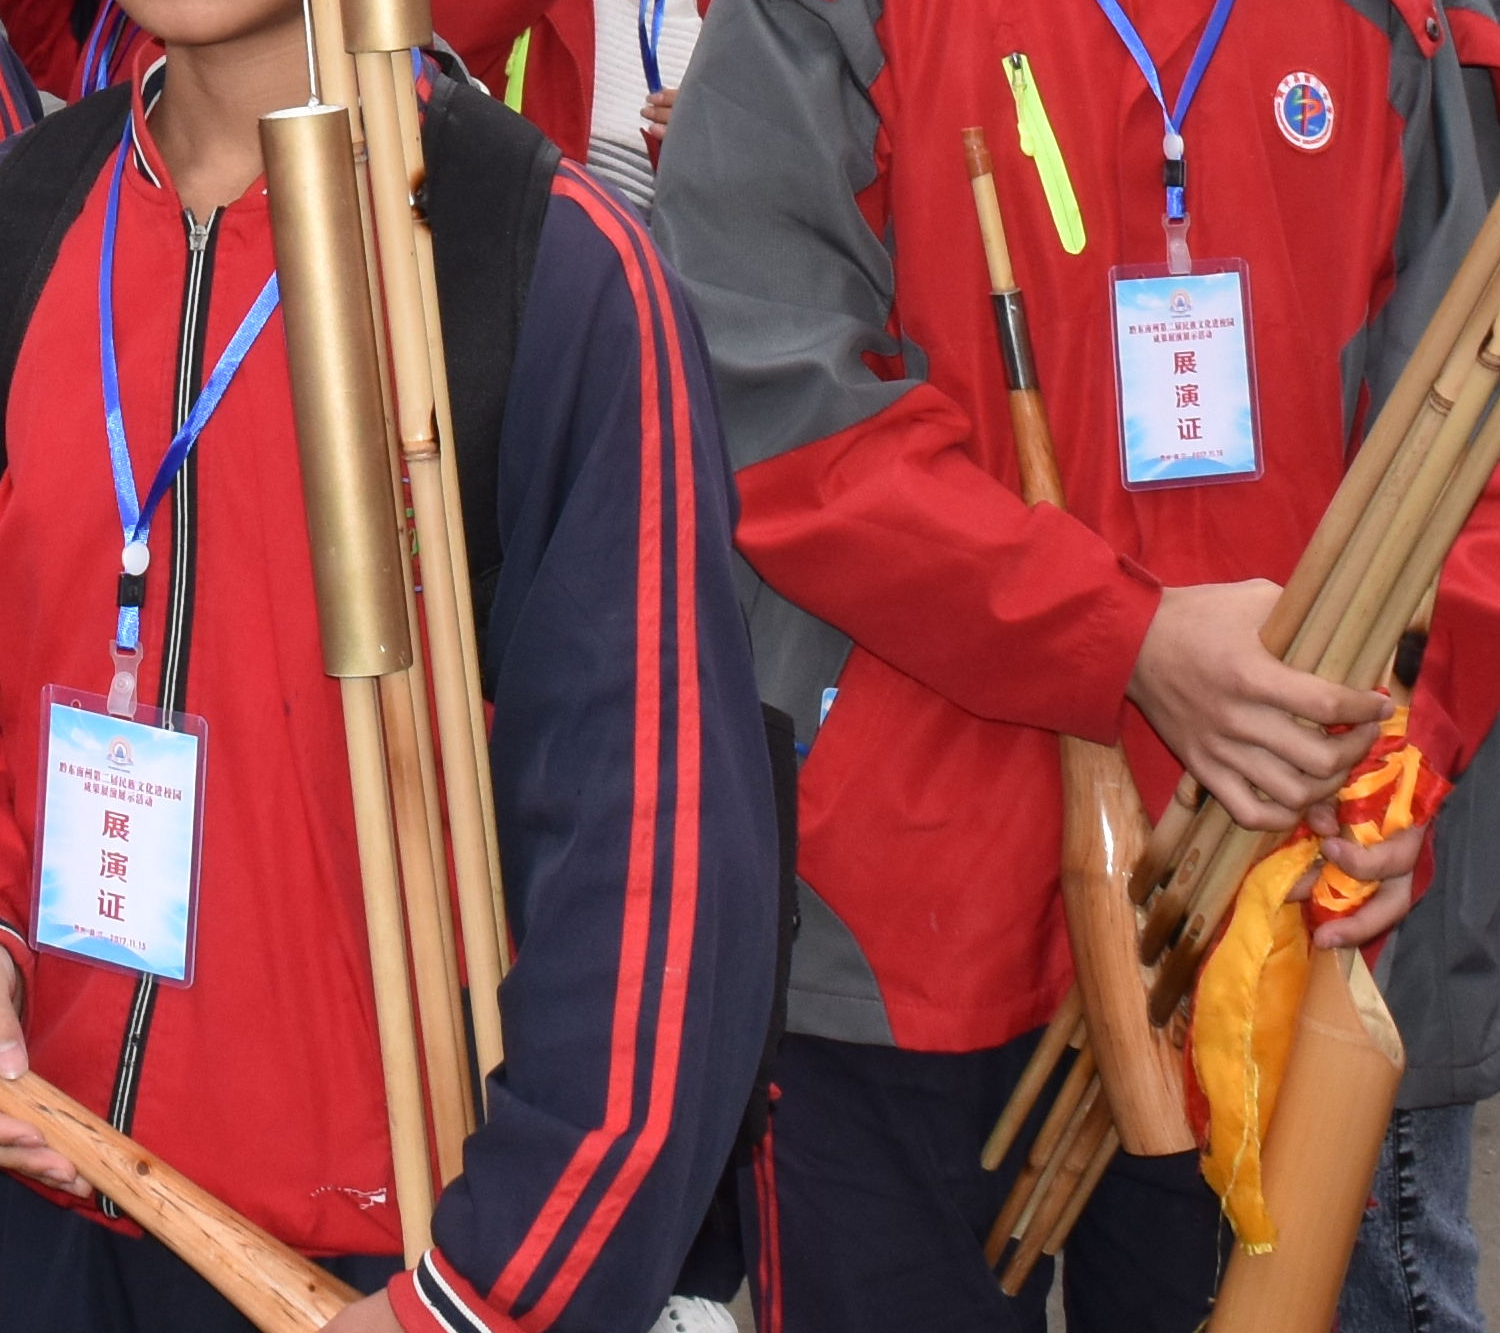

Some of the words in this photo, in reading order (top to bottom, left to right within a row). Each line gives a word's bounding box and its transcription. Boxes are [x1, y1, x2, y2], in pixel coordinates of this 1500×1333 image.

[1173, 351, 1203, 441] 展演证
[97, 809, 130, 923] 展演证
